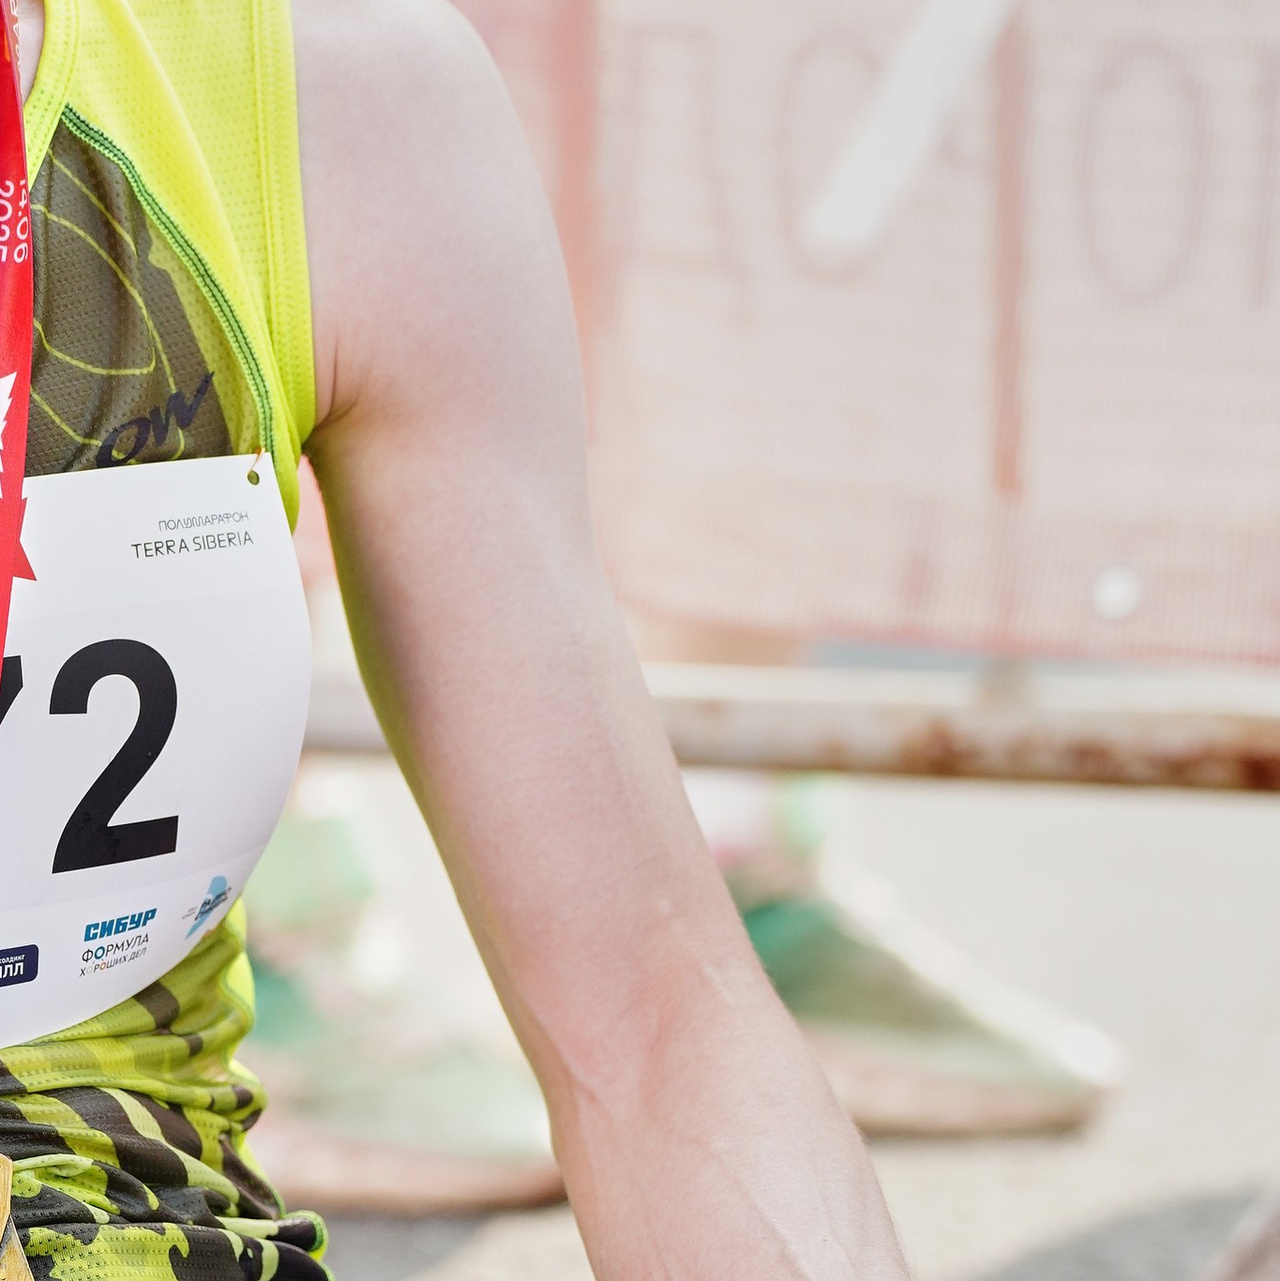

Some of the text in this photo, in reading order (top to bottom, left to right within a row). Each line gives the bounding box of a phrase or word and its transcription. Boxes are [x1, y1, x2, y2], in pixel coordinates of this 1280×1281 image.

[158, 510, 250, 532] ПОЛУМАРАФОН
[131, 531, 255, 559] TERRA SIBERIA
[84, 908, 157, 942] СИБУР
[79, 947, 147, 977] ХОРОШИХ ДЕЛ
[81, 933, 149, 963] ФОРМУЛА
